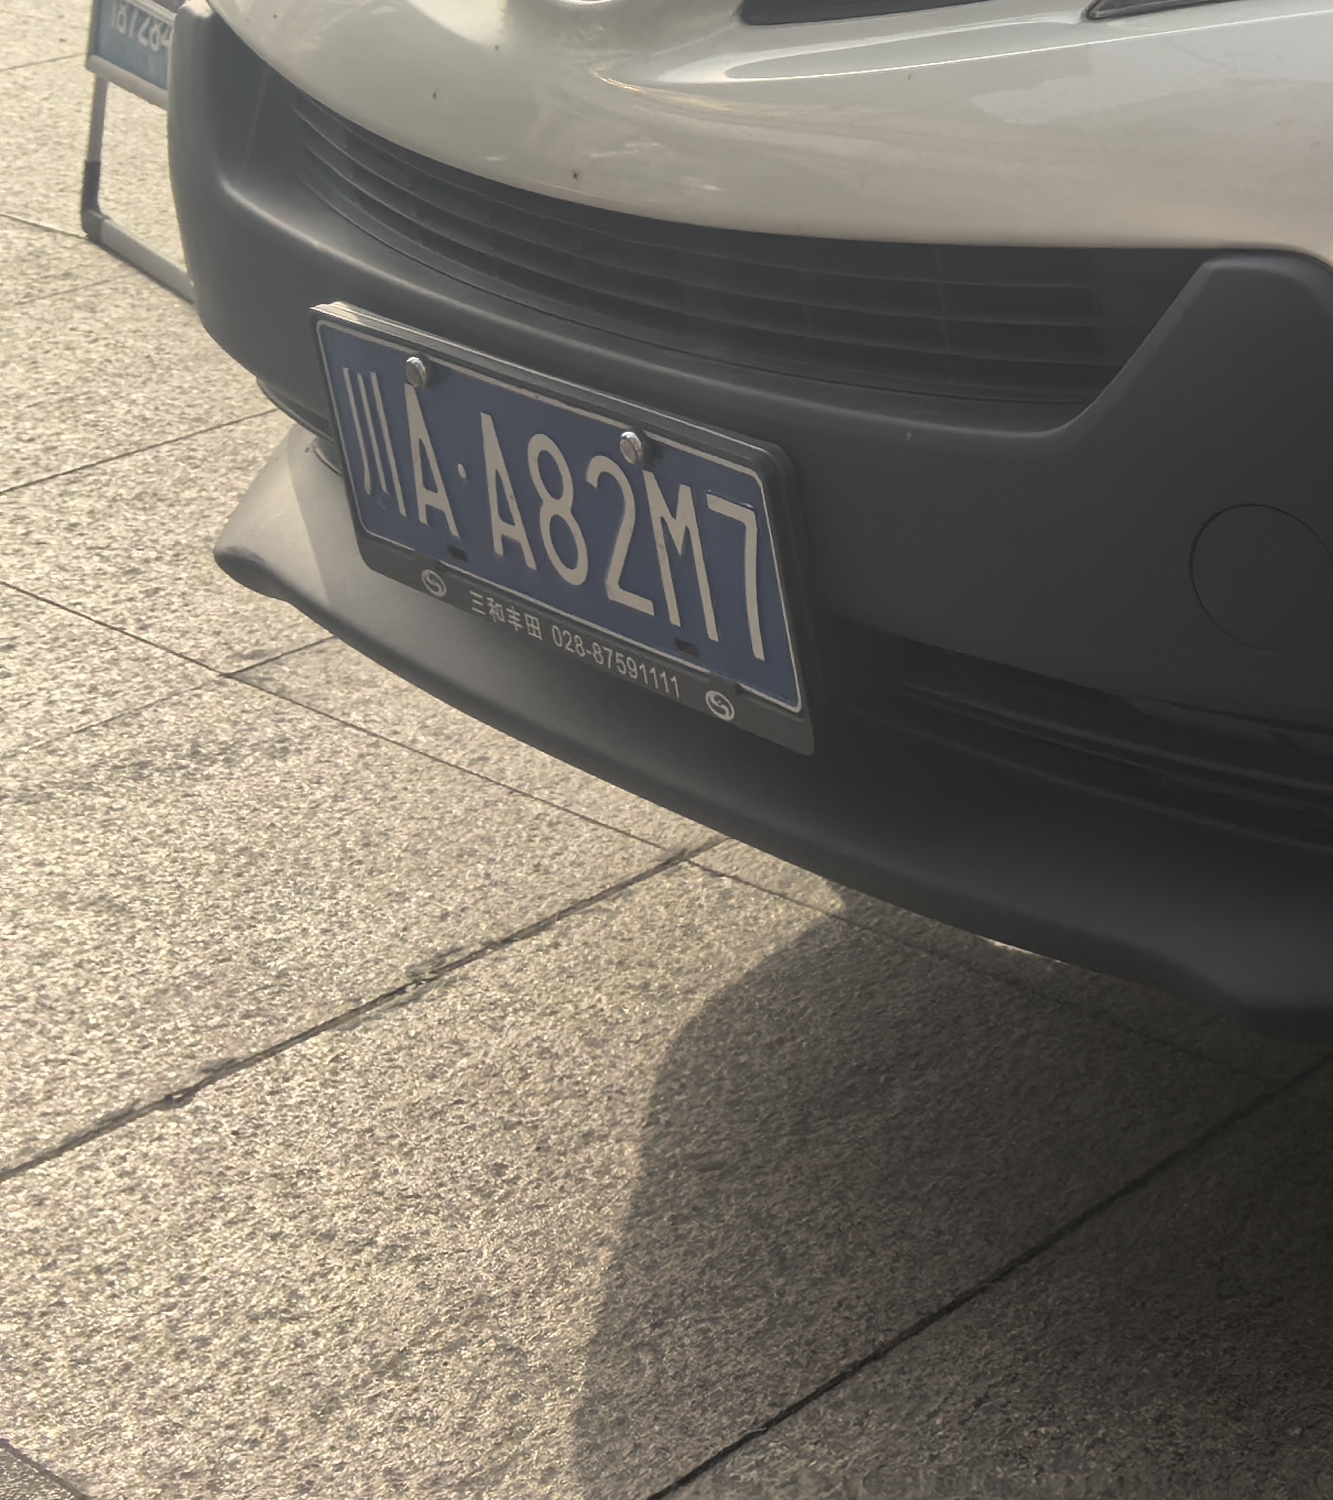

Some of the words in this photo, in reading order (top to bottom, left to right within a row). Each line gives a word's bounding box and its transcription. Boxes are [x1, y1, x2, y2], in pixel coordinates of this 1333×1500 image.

[470, 590, 542, 640] 三和丰田
[552, 625, 680, 699] 028-87591111
